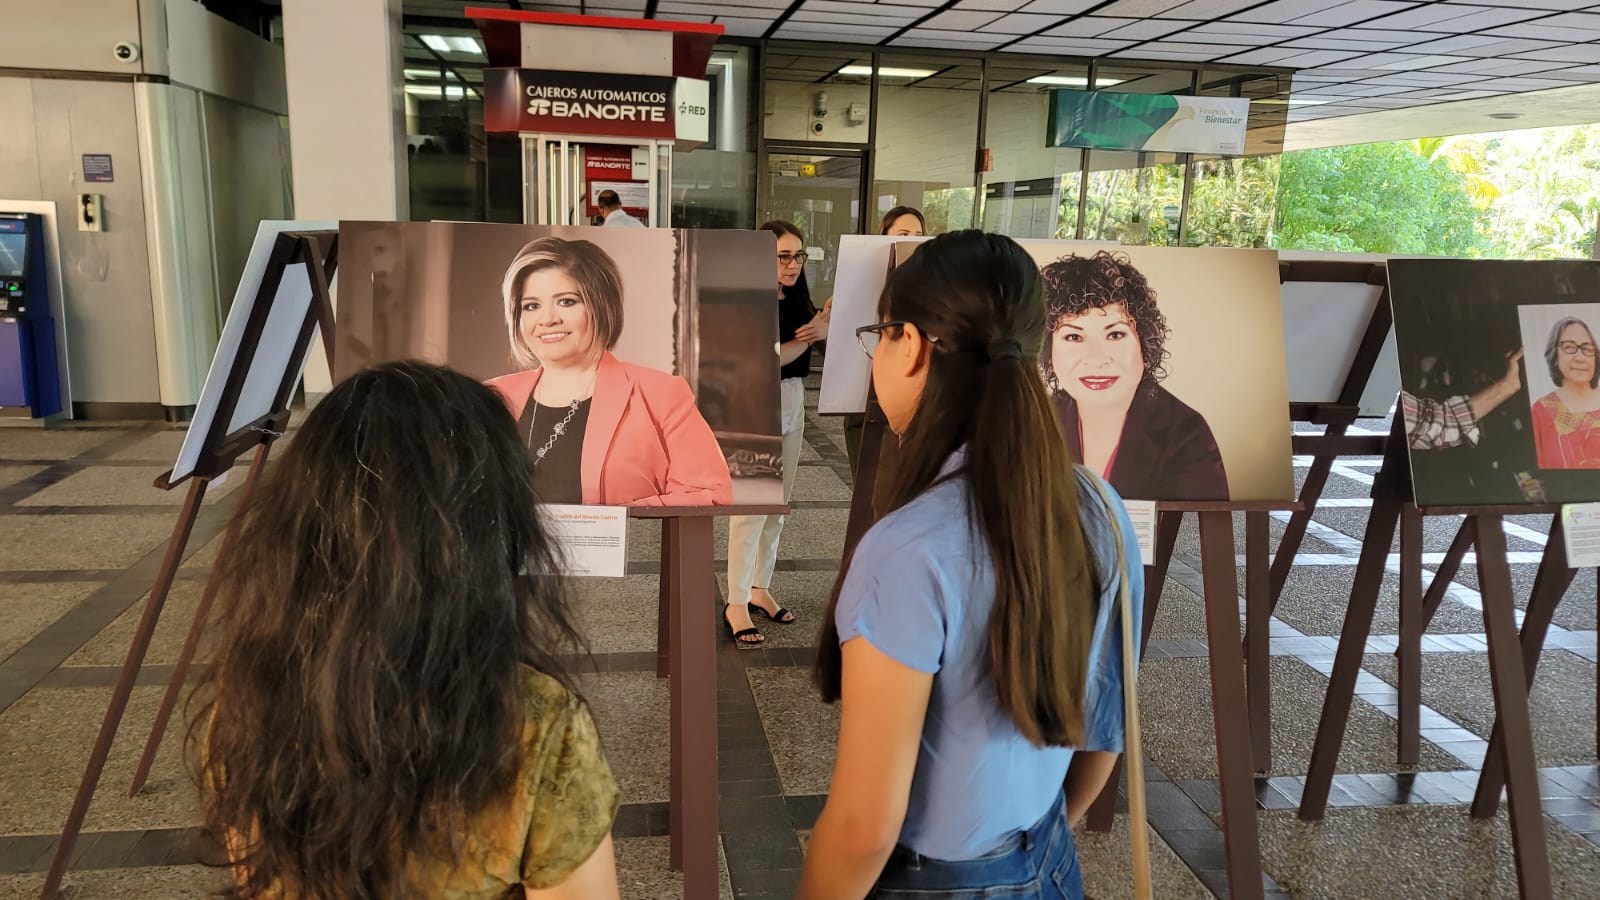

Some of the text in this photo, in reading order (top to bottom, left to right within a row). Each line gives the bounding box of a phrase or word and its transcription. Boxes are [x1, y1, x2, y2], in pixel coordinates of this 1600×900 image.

[526, 85, 666, 103] CAJEROS AUTOMATICOS
[552, 102, 666, 122] BANORTE
[688, 106, 706, 116] RED
[1205, 114, 1243, 124] Bienestar
[594, 161, 631, 170] BANORTE
